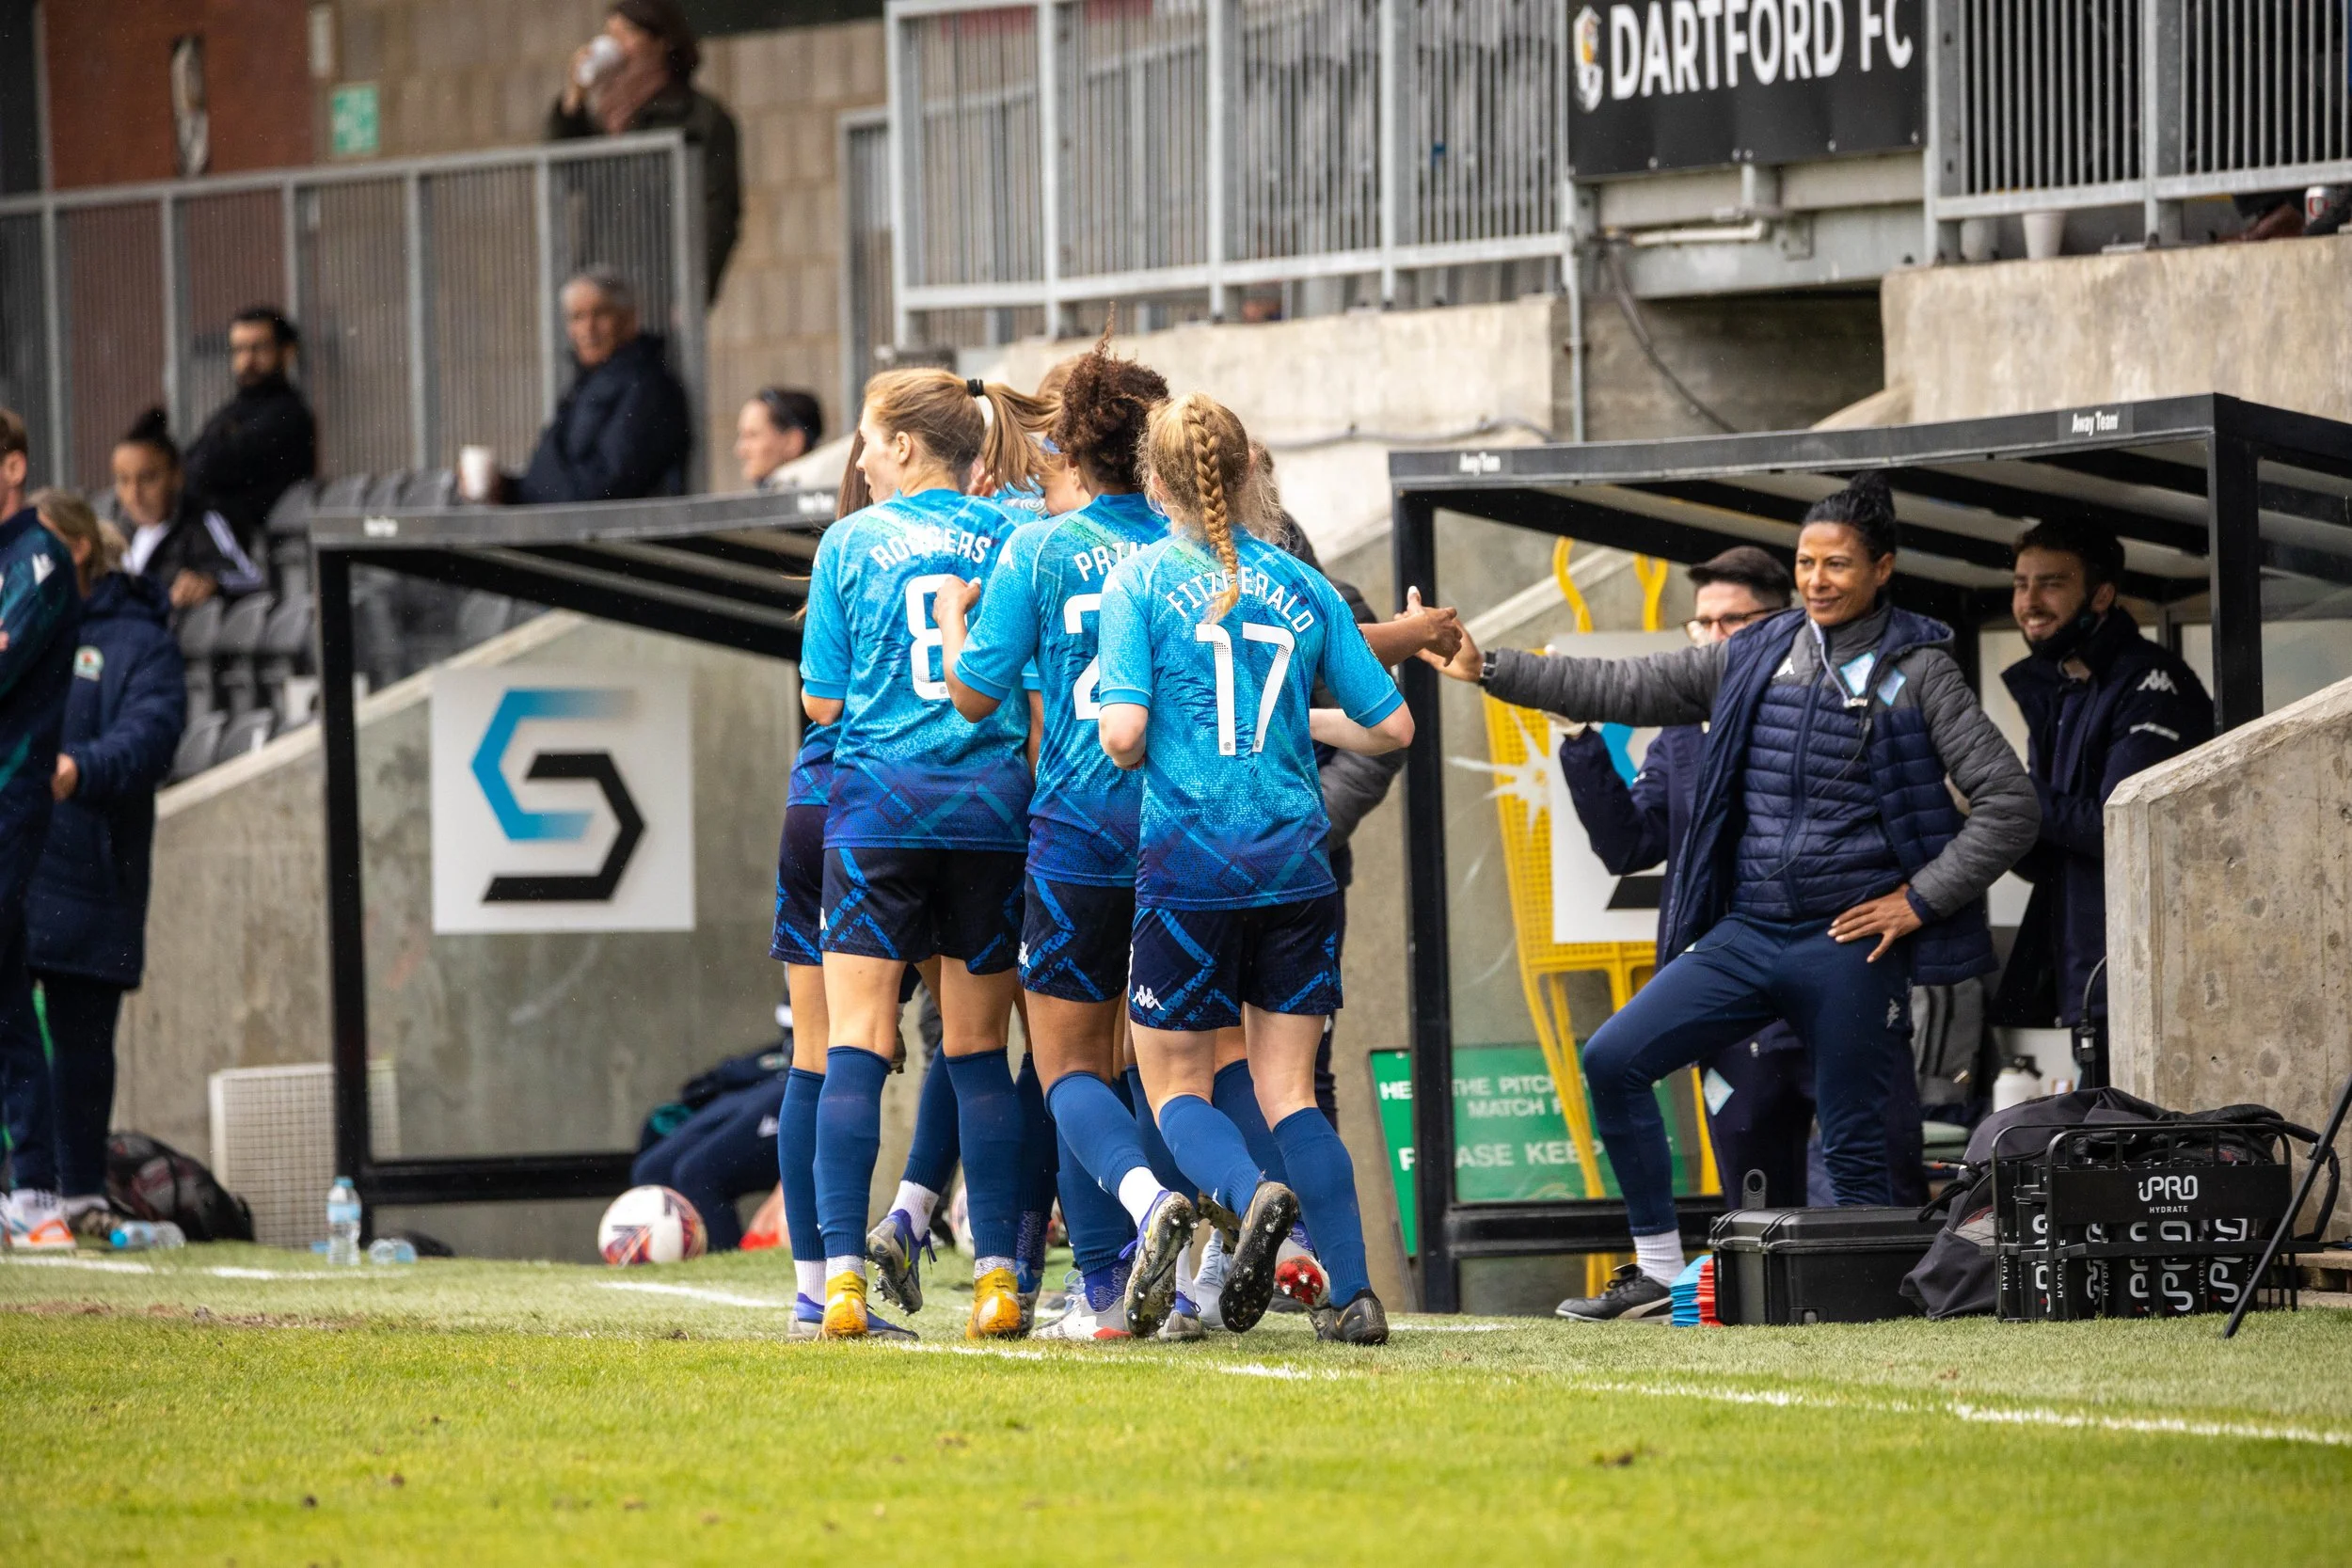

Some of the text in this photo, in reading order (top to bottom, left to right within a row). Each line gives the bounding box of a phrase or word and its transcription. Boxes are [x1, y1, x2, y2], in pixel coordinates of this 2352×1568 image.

[1610, 0, 1913, 101] DARTFORD FC
[905, 574, 968, 700] 8
[1063, 593, 1100, 721] 2
[1195, 622, 1295, 756] 17
[1379, 1080, 1414, 1101] HE
[1466, 1097, 1546, 1118] MATCH
[2149, 1205, 2189, 1214] HYDRATE
